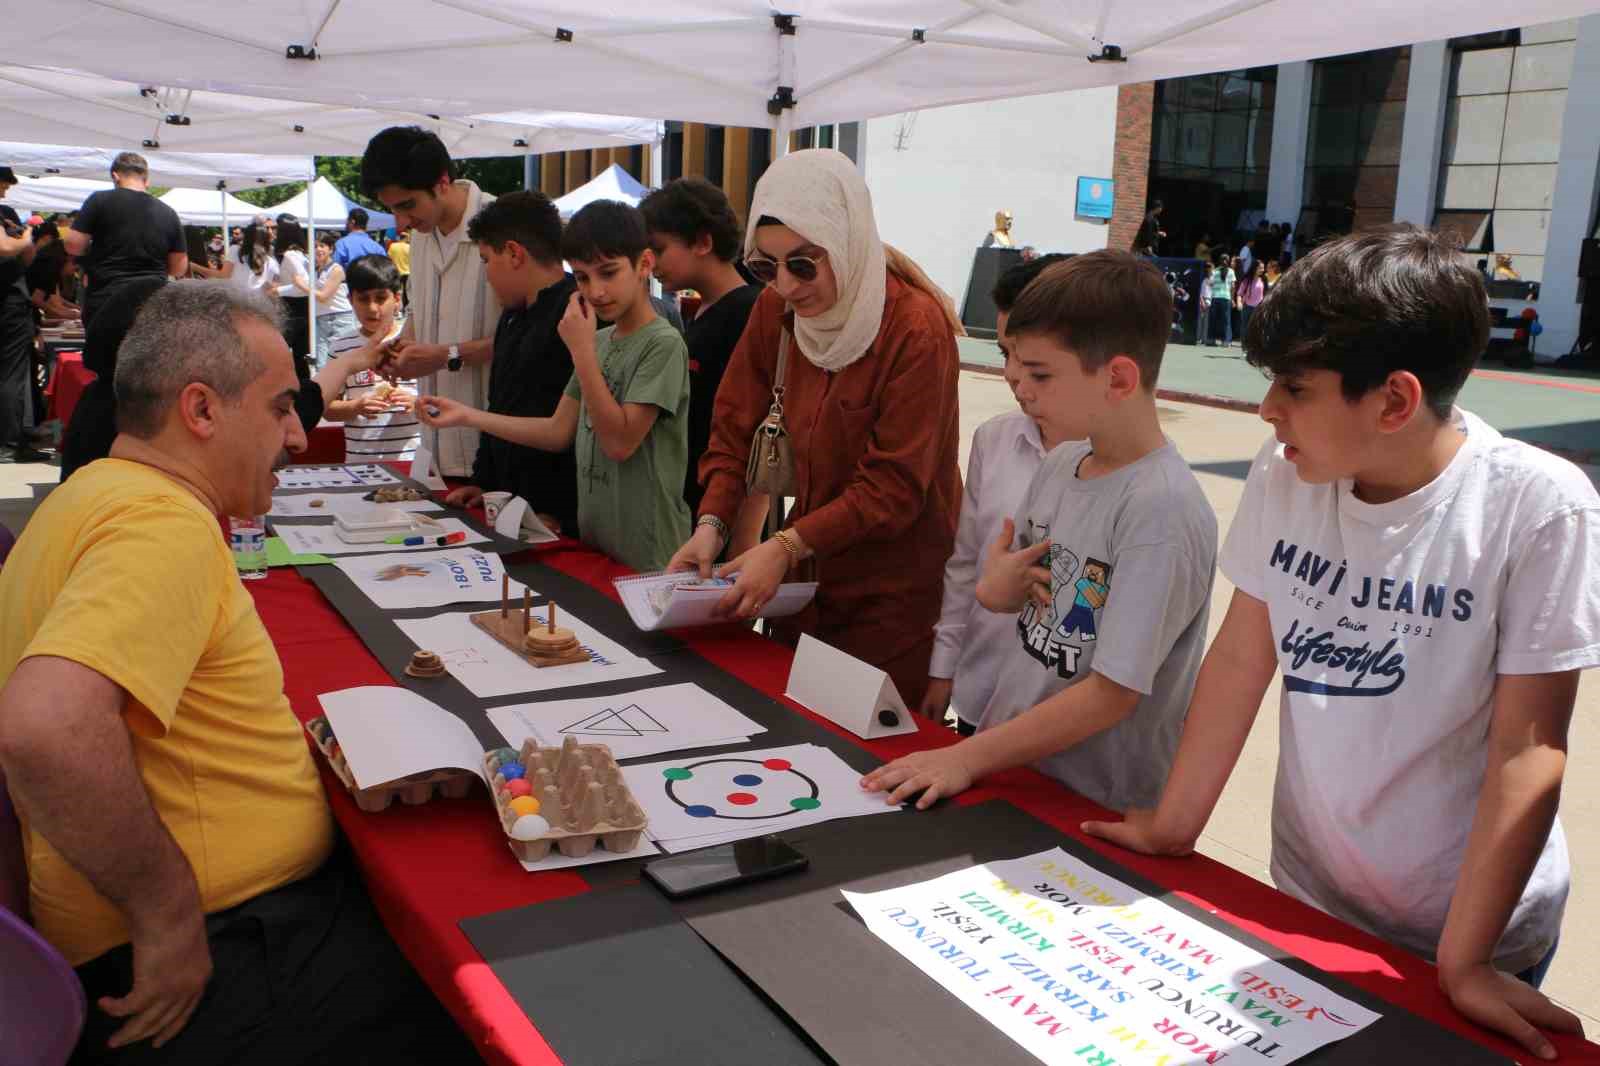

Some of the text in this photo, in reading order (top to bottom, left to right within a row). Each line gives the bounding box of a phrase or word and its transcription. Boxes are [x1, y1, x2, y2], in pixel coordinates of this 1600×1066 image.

[1351, 576, 1475, 622] JEANS
[1390, 621, 1433, 638] 1991
[1280, 619, 1406, 690] Lifestyle
[1034, 882, 1092, 916] MOR
[880, 906, 992, 982] TURUNCU
[1096, 923, 1204, 983] KIRMIZI
[959, 890, 1231, 1065] MOR SARI KIRMIZI
[984, 984, 1071, 1036] MAVİ
[1000, 952, 1109, 1022] KIRMIZI
[1138, 978, 1283, 1058] TURUNCU
